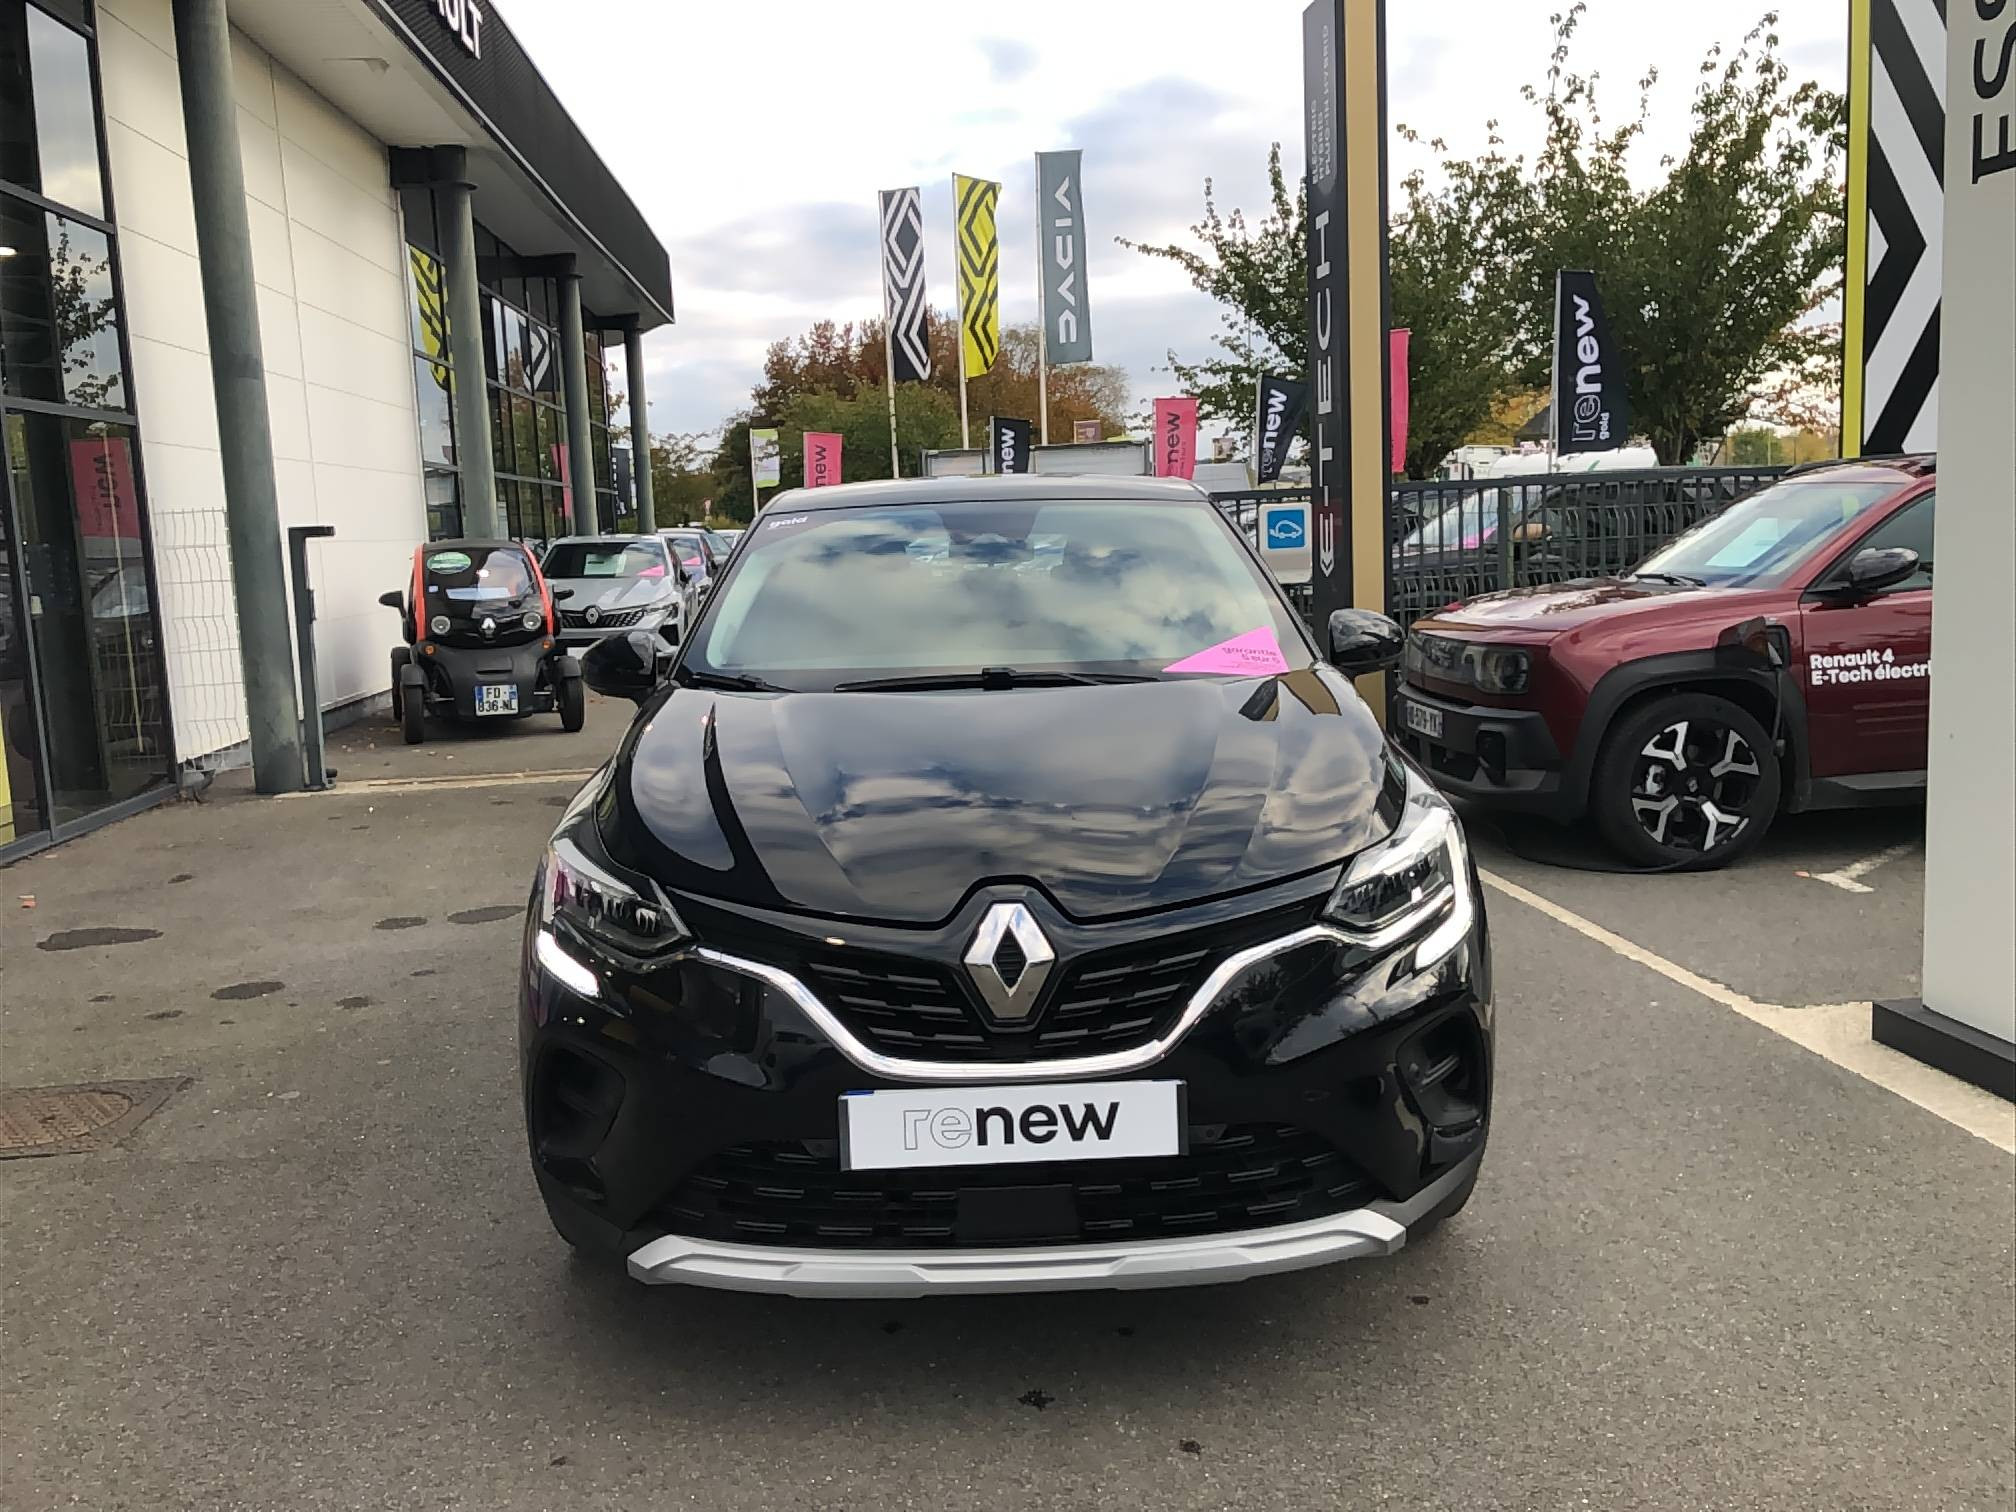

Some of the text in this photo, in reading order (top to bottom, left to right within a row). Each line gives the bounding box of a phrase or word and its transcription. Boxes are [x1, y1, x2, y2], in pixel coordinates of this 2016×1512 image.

[438, 0, 483, 60] ULT
[1972, 0, 2016, 184] ES
[1055, 176, 1077, 344] DACIA
[1315, 210, 1334, 578] E-TECH
[1571, 294, 1602, 442] renew
[1600, 412, 1610, 441] gold
[1810, 648, 1895, 670] Renault 4
[1811, 665, 1873, 686] E-Tech
[486, 687, 501, 698] FD
[903, 1101, 1121, 1151] renew
